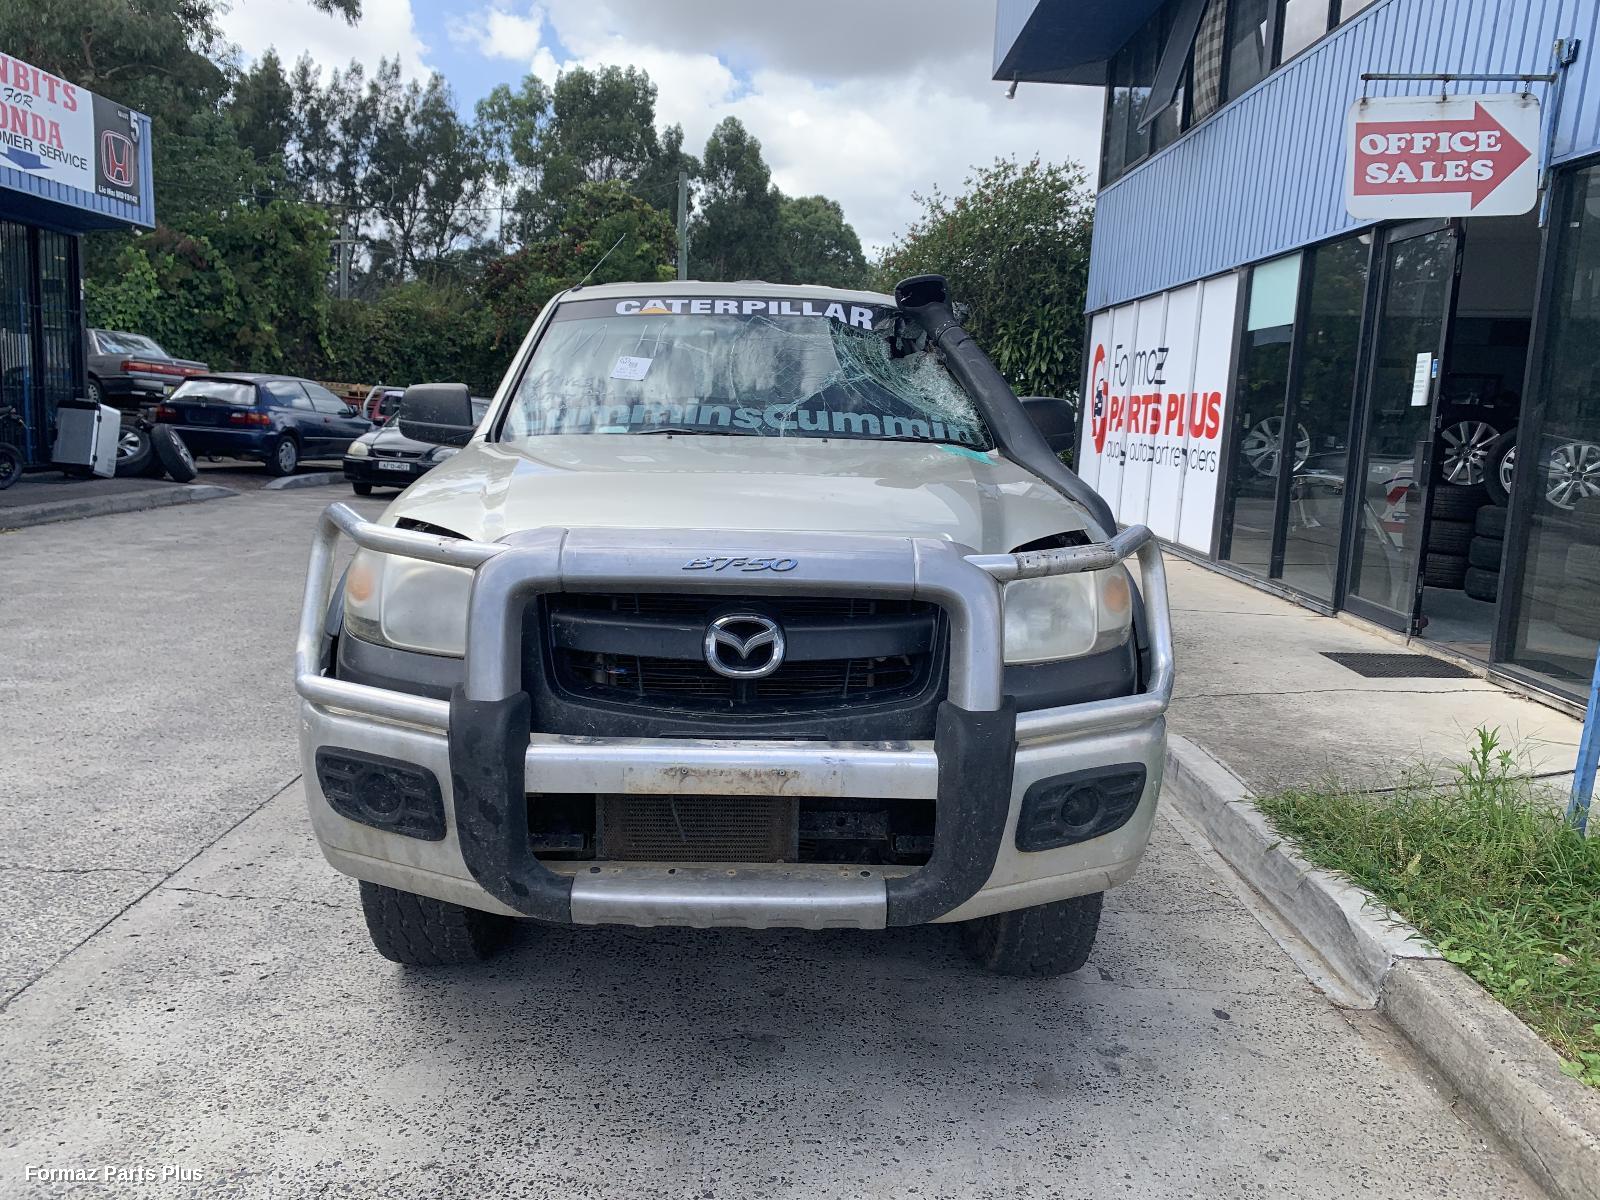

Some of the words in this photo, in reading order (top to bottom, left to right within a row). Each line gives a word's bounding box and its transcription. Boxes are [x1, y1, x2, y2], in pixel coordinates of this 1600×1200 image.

[3, 87, 33, 109] FOR
[130, 110, 140, 143] 5
[0, 130, 33, 151] MER
[39, 143, 88, 171] SERVICE
[1359, 130, 1502, 156] OFFICE
[1365, 159, 1494, 184] SALES
[615, 299, 874, 331] CATERPILLAR
[1112, 344, 1169, 387] Fomaz
[1109, 392, 1162, 435] PARTS
[1164, 391, 1222, 440] PLUS
[1170, 441, 1217, 473] reclers
[682, 556, 799, 572] BT-50
